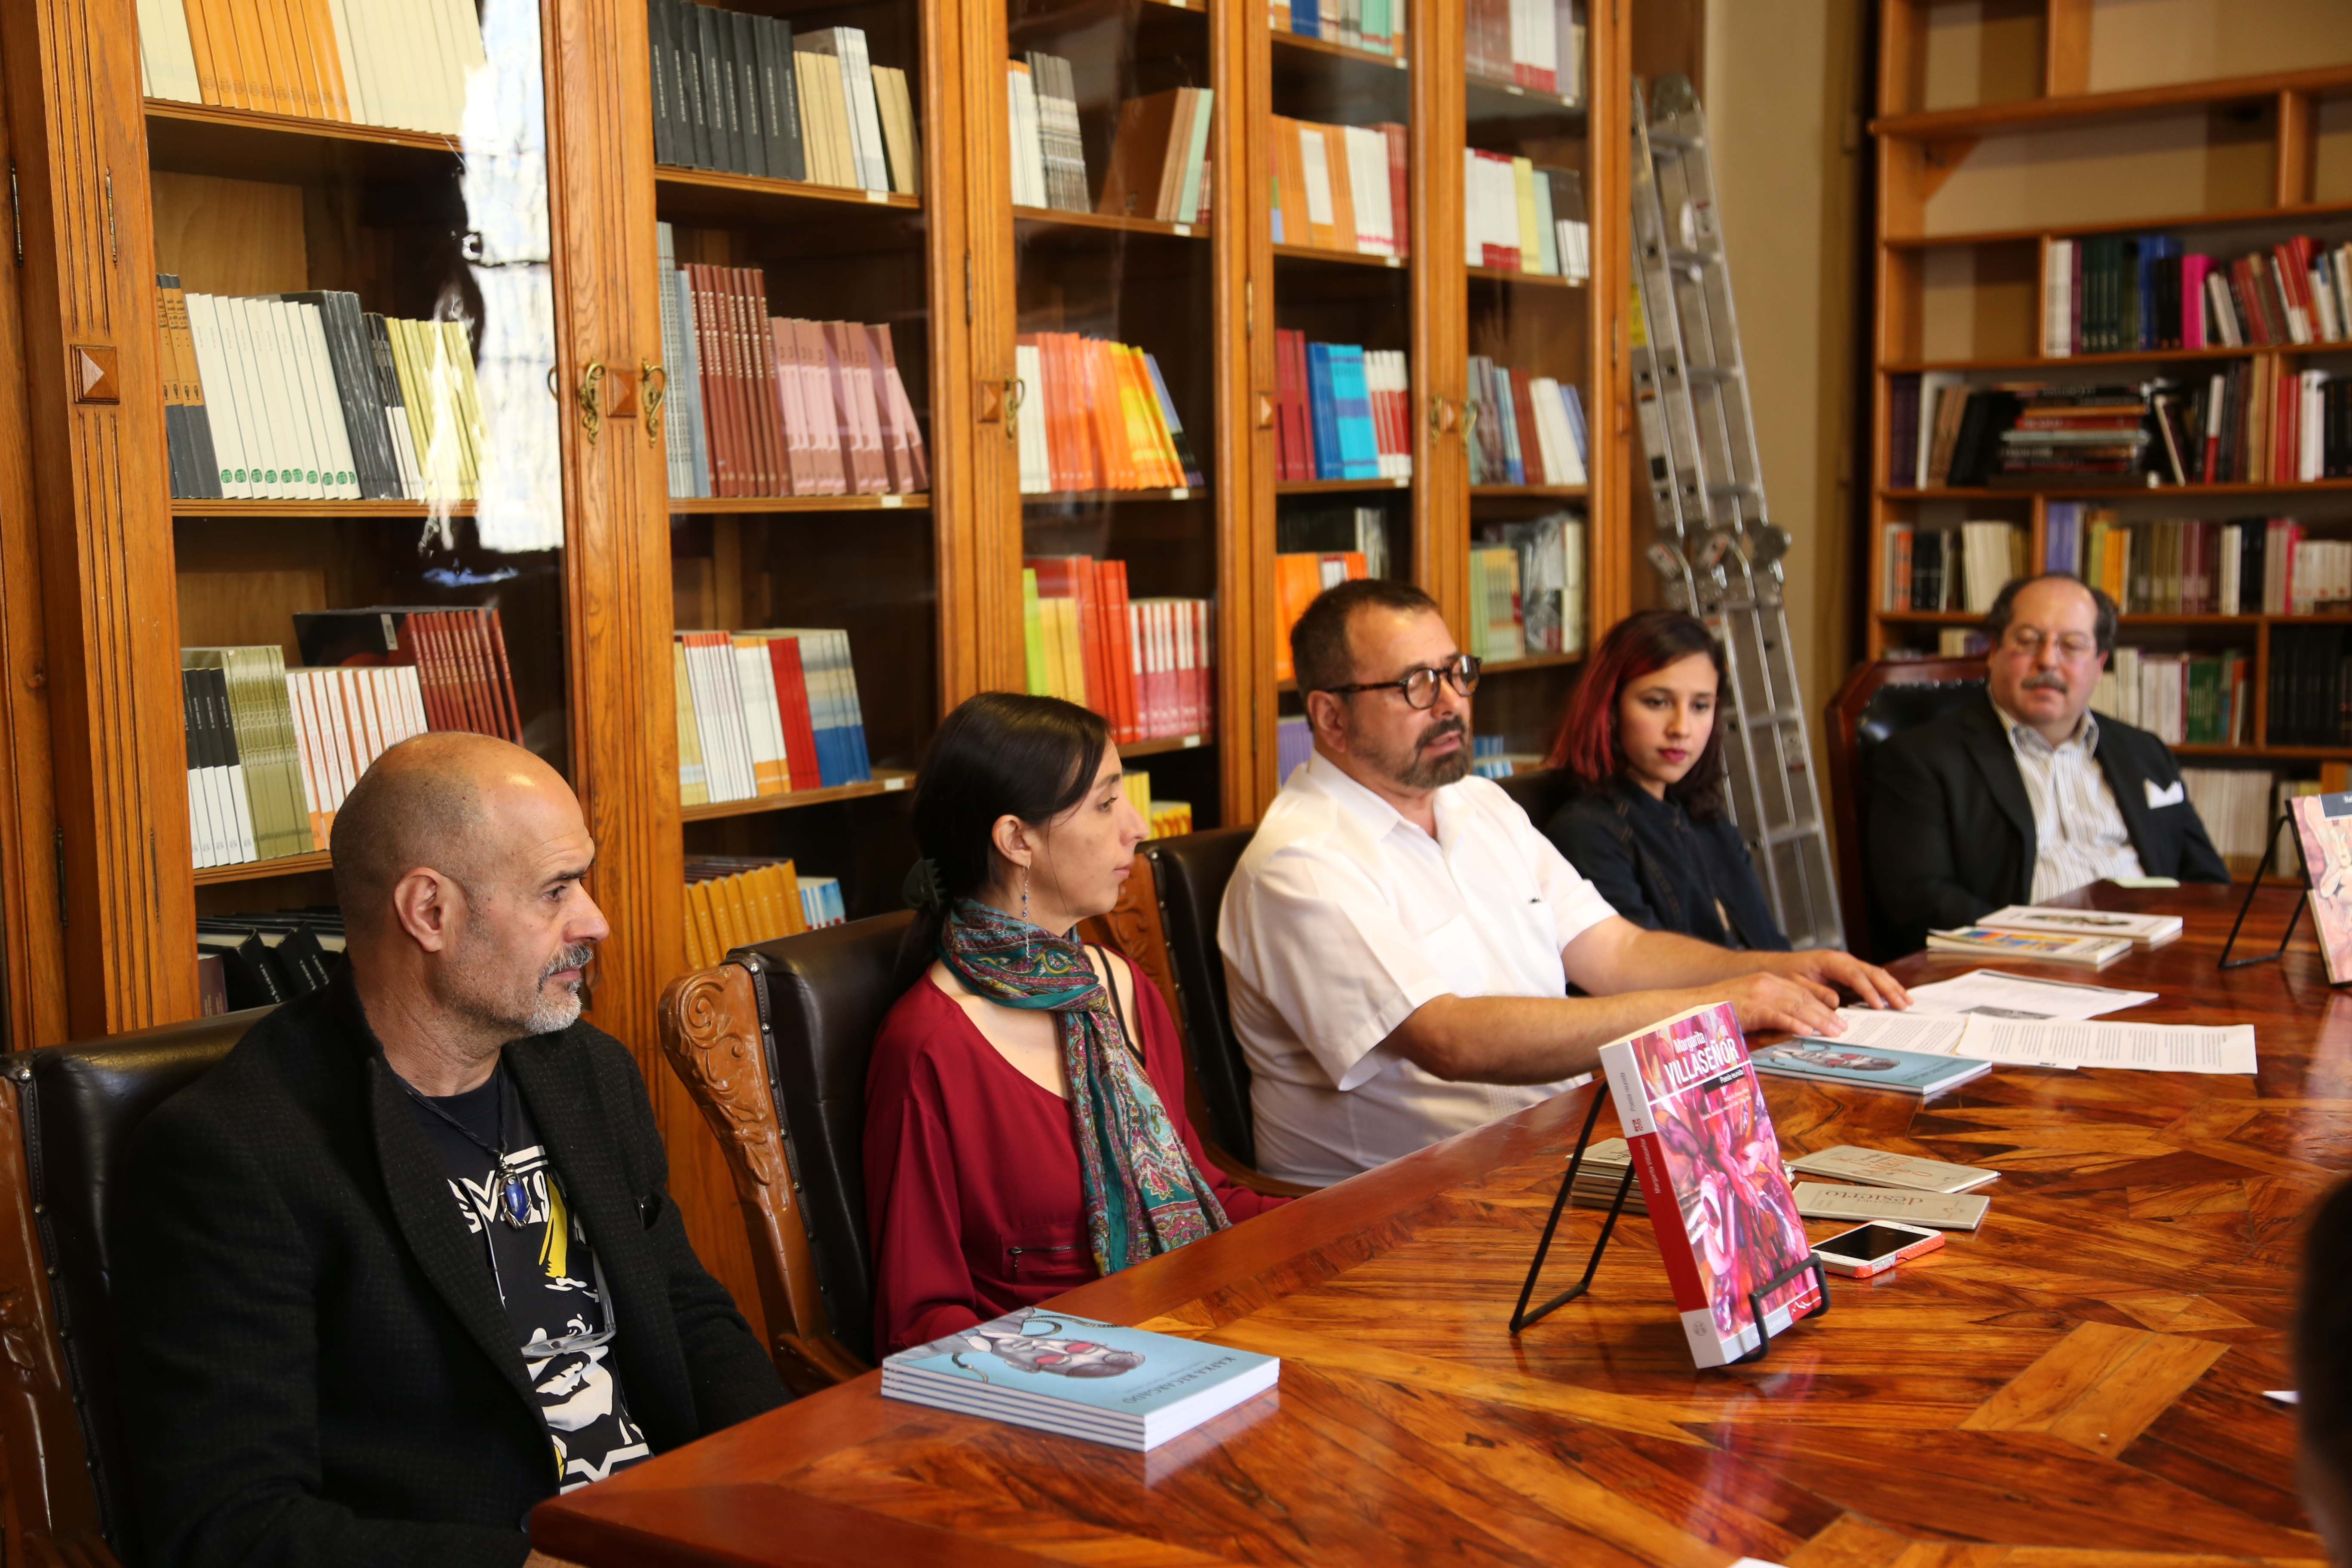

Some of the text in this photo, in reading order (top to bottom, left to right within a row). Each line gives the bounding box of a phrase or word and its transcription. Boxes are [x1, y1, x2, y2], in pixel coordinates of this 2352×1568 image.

[1673, 1031, 1706, 1054] Margarita
[1663, 1038, 1740, 1087] VILLASEÑOR
[1620, 1072, 1631, 1093] reunida
[1639, 1138, 1661, 1194] Margarita Villaseñor
[1825, 1190, 1923, 1205] desierto
[1194, 1357, 1236, 1375] KAFKA
